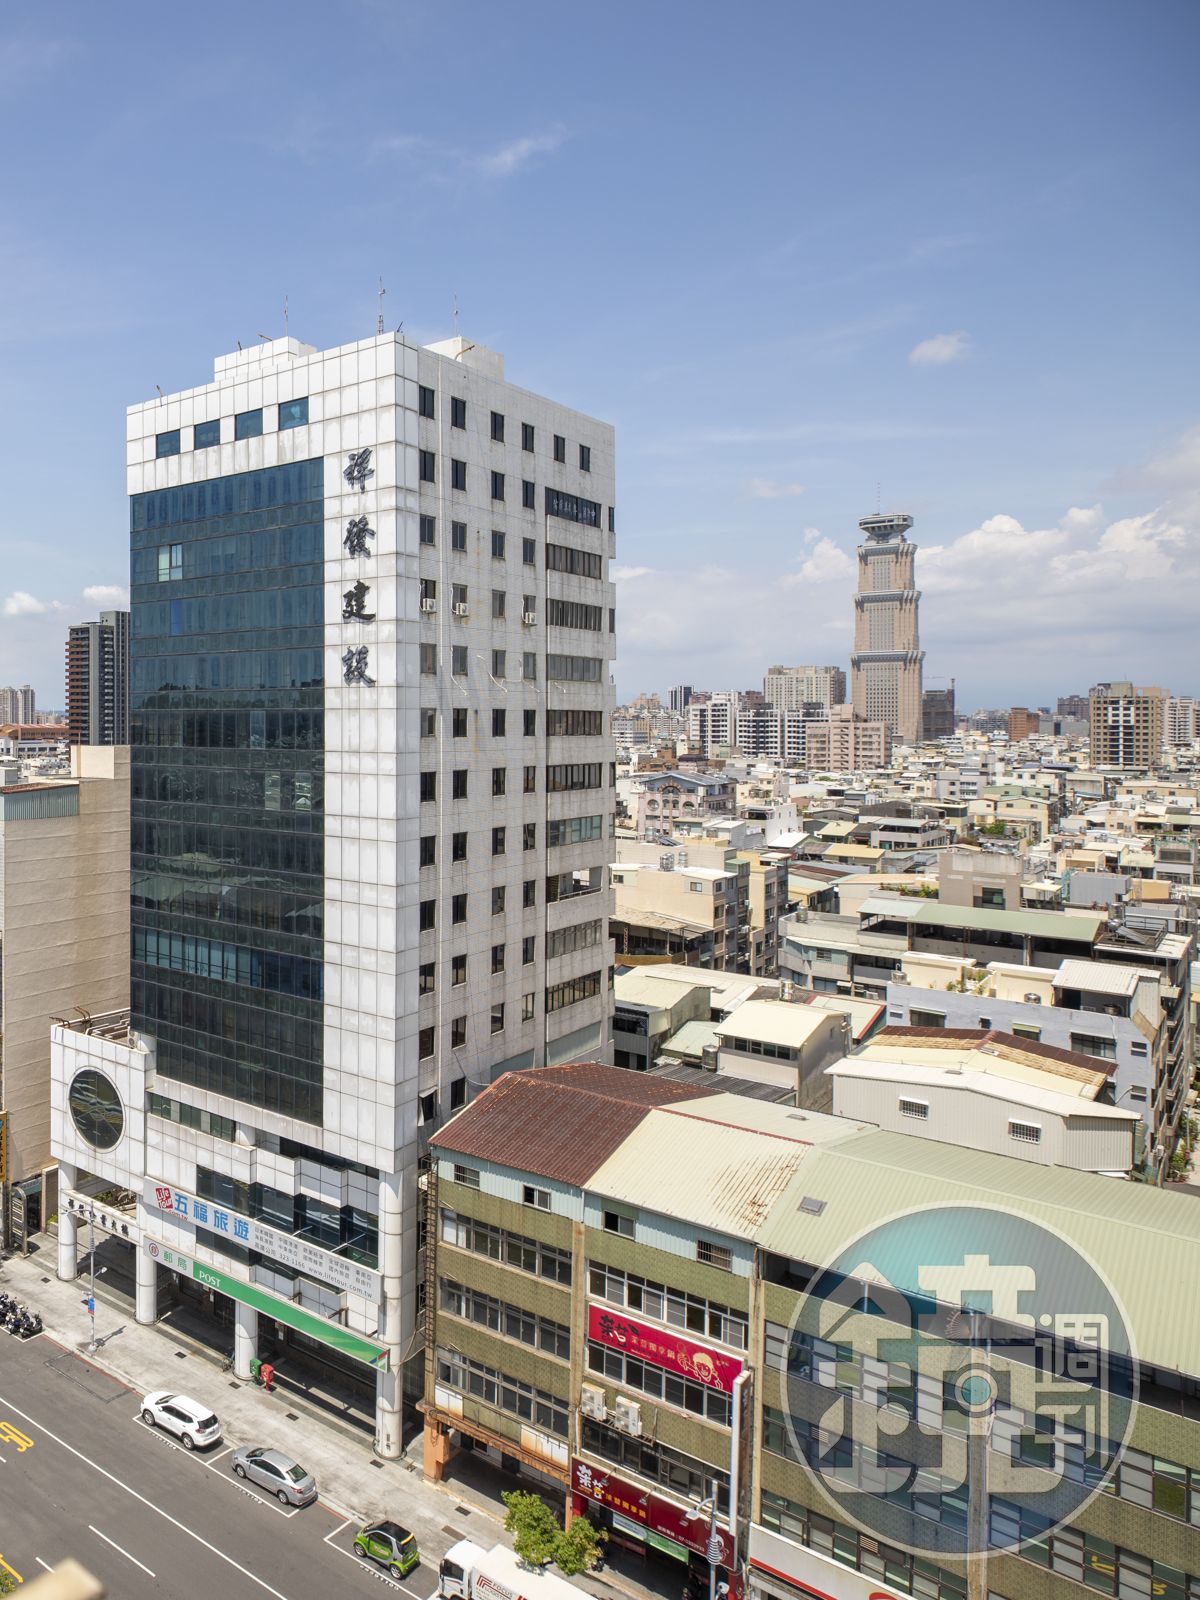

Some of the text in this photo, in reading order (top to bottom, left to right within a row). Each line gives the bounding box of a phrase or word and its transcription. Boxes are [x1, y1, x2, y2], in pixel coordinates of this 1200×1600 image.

[175, 1193, 249, 1241] 五福旅遊
[164, 1251, 187, 1270] 郵局
[200, 1271, 221, 1287] POST
